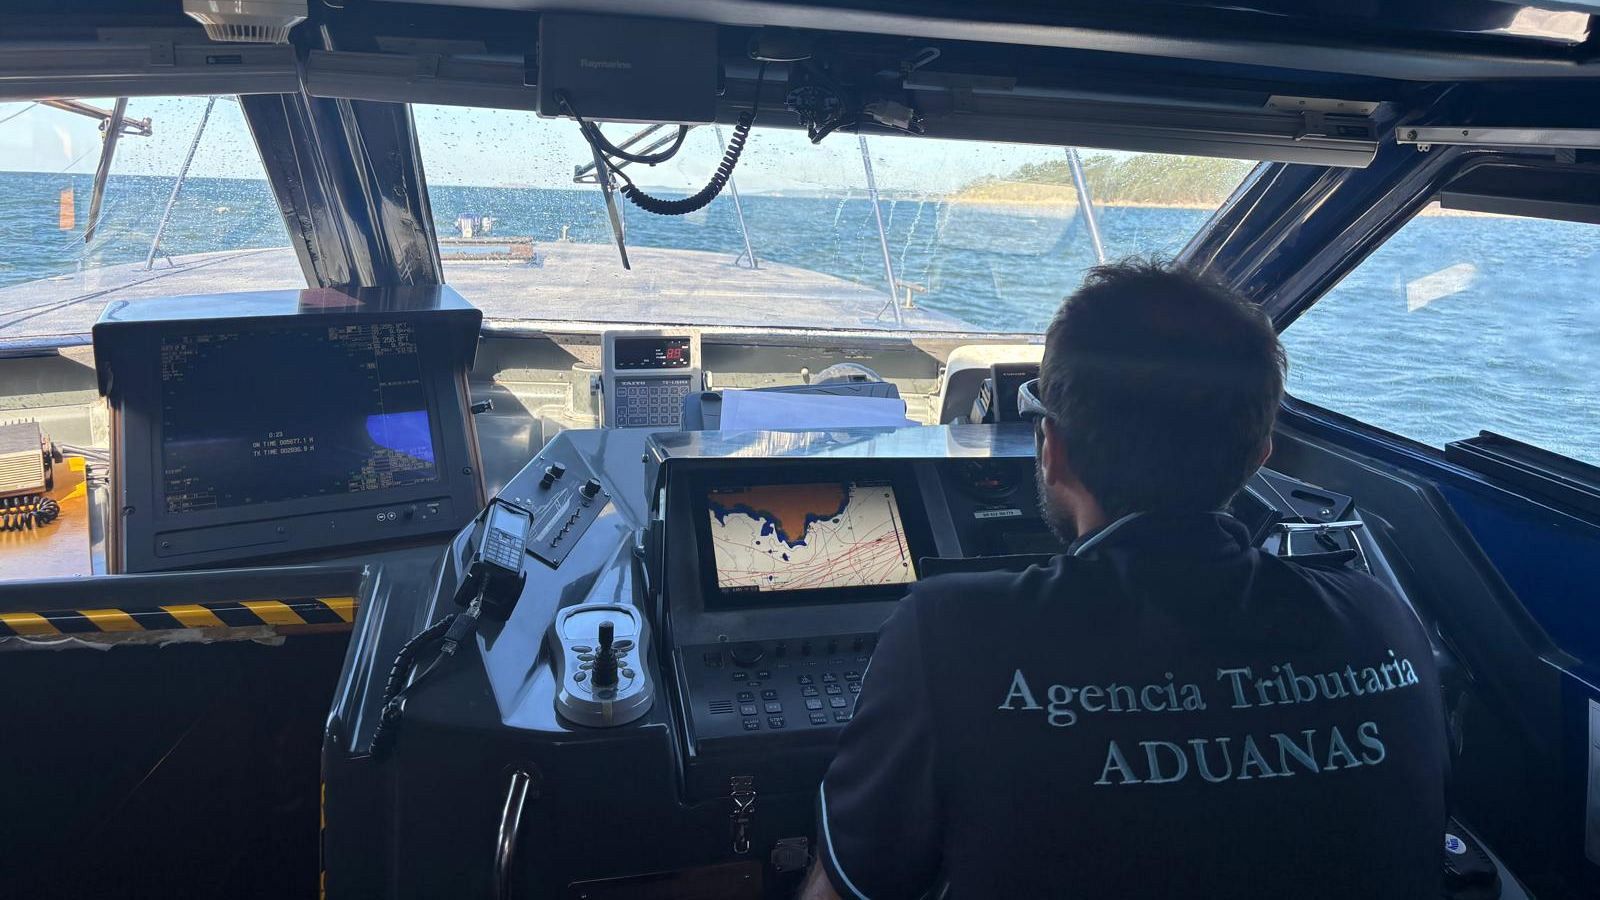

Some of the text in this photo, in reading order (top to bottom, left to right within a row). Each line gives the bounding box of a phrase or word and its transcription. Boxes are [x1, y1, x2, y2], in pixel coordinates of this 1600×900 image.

[998, 649, 1420, 728] Agencia Tributaria
[1094, 721, 1387, 786] ADUANAS
